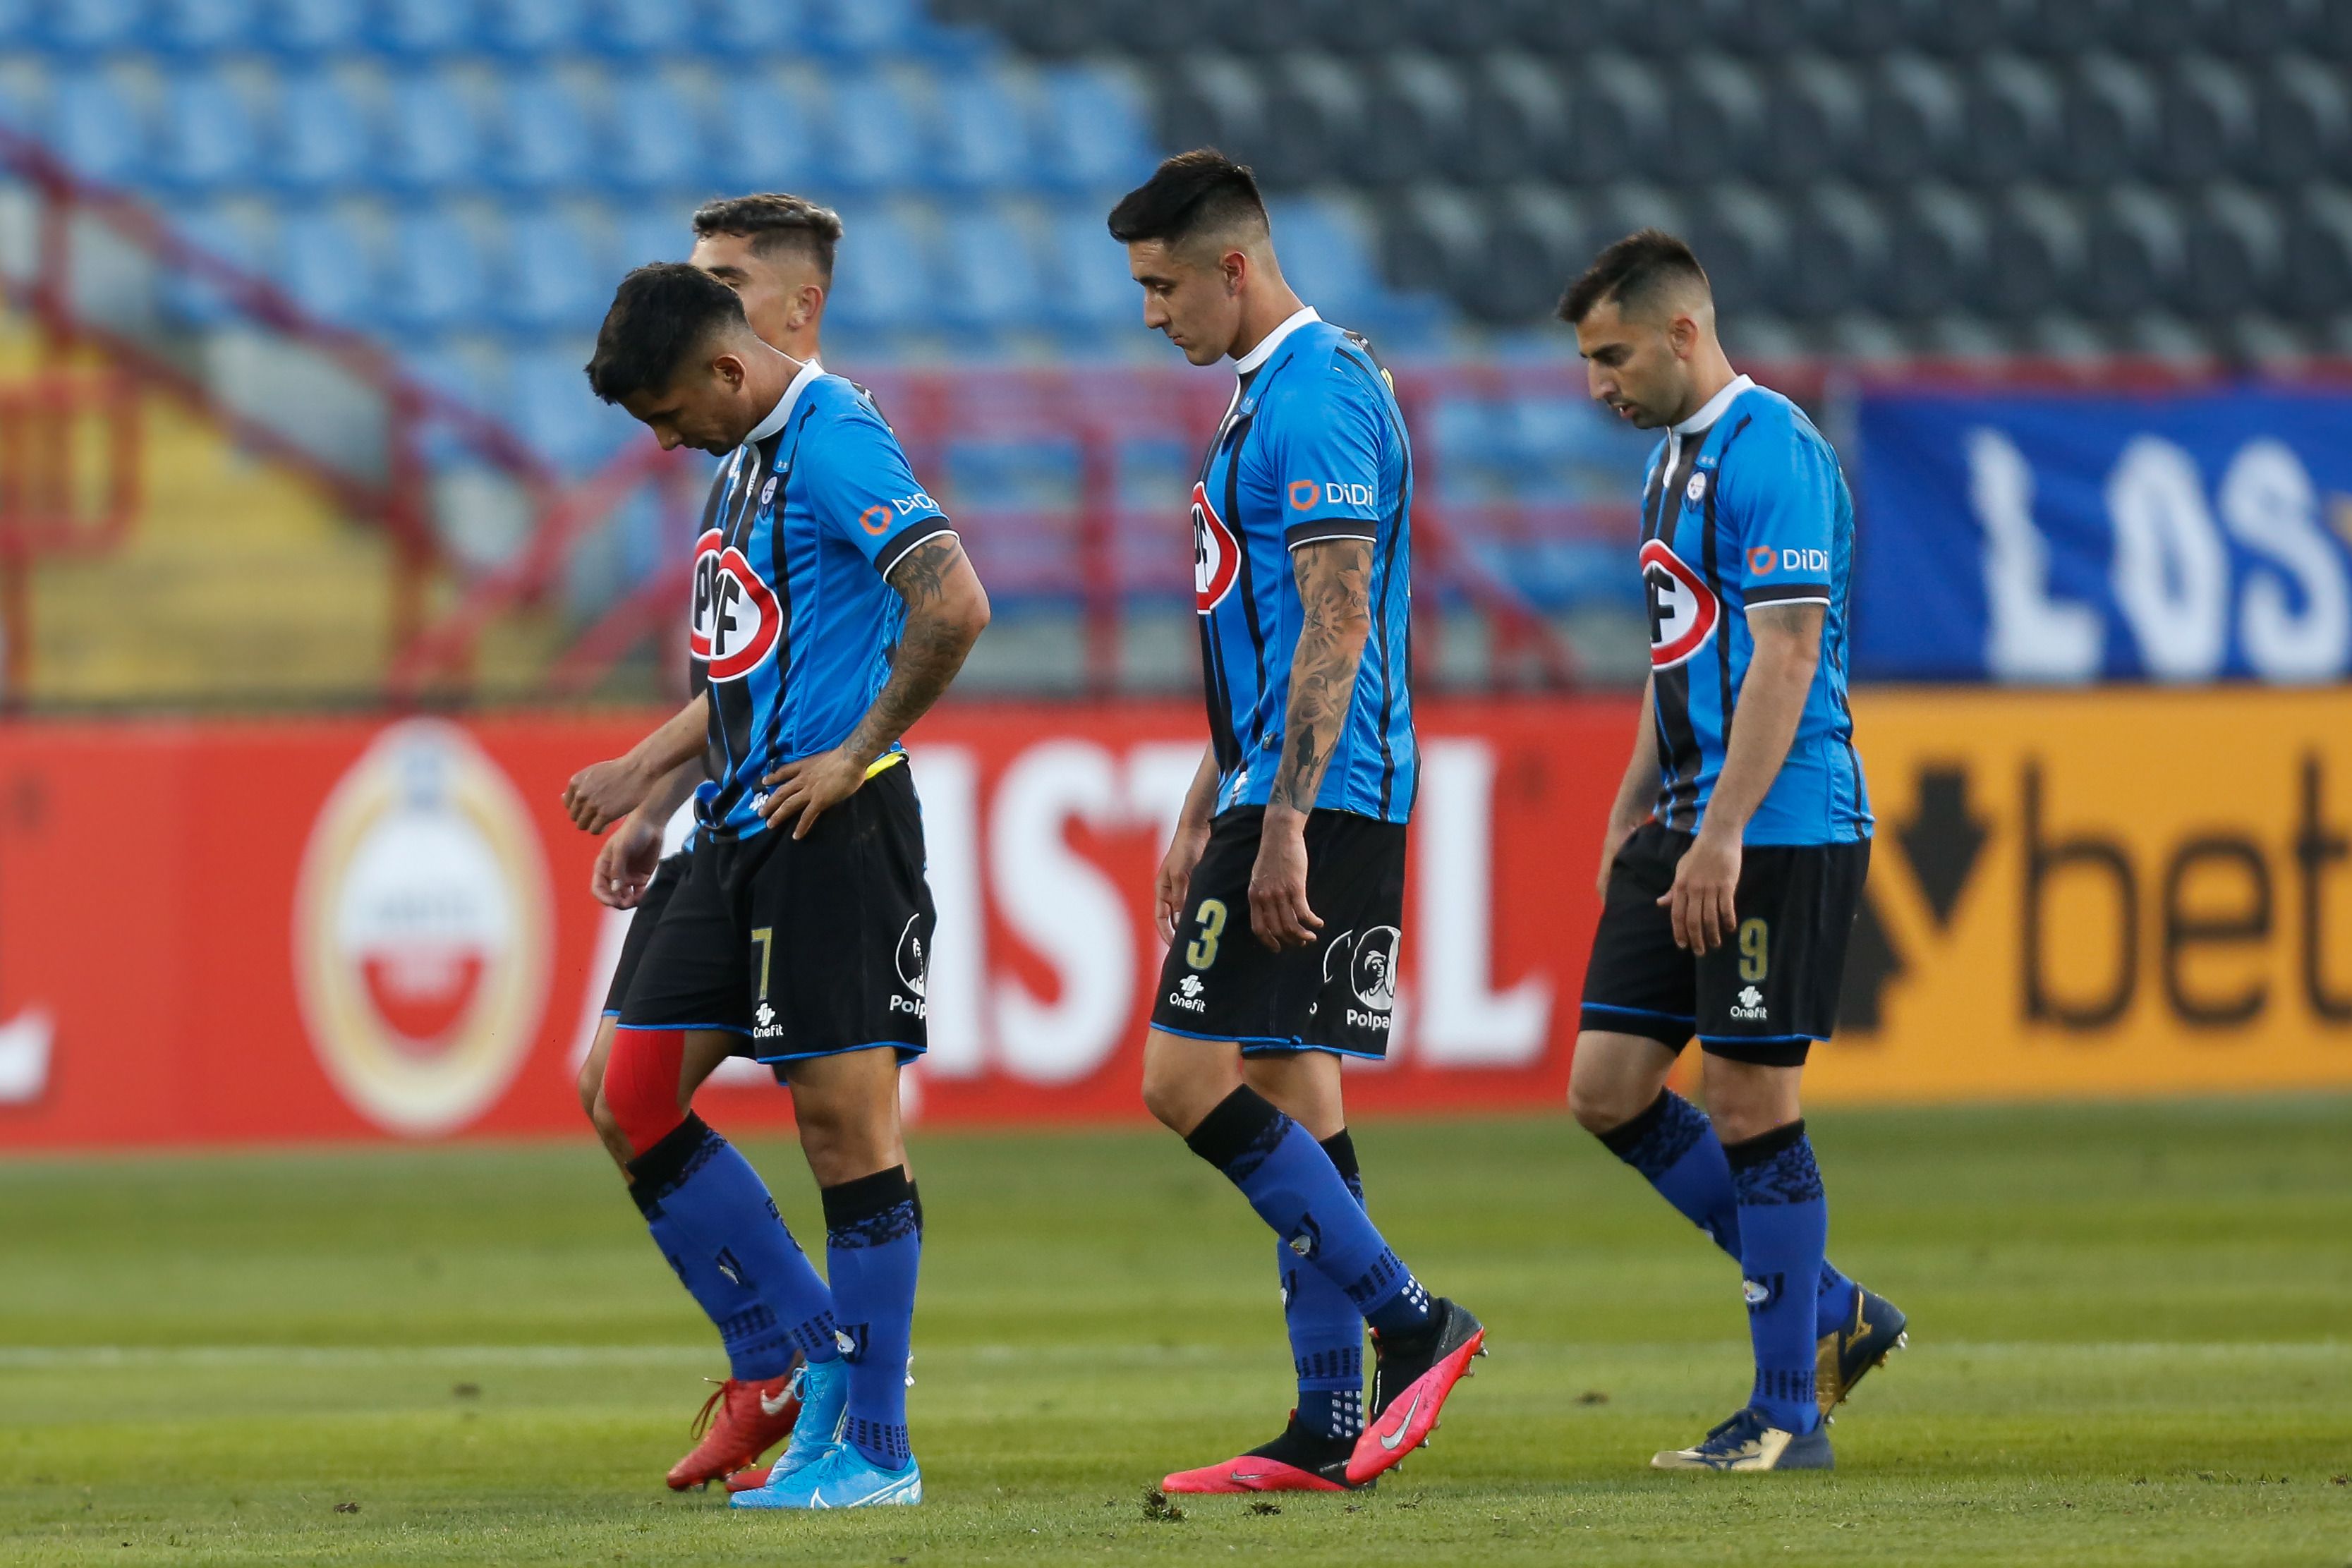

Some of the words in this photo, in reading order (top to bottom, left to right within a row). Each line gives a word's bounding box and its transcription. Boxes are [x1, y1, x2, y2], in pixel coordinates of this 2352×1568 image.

[1326, 482, 1373, 506] DiDi
[1782, 549, 1829, 571] DiDi
[1965, 427, 2349, 686] LOS
[2019, 751, 2352, 1031] bet
[751, 927, 772, 1001] 7
[1186, 898, 1227, 971] 3
[1739, 918, 1768, 981] 9
[1169, 992, 1206, 1013] Onefit
[1730, 1006, 1767, 1019] Onefit
